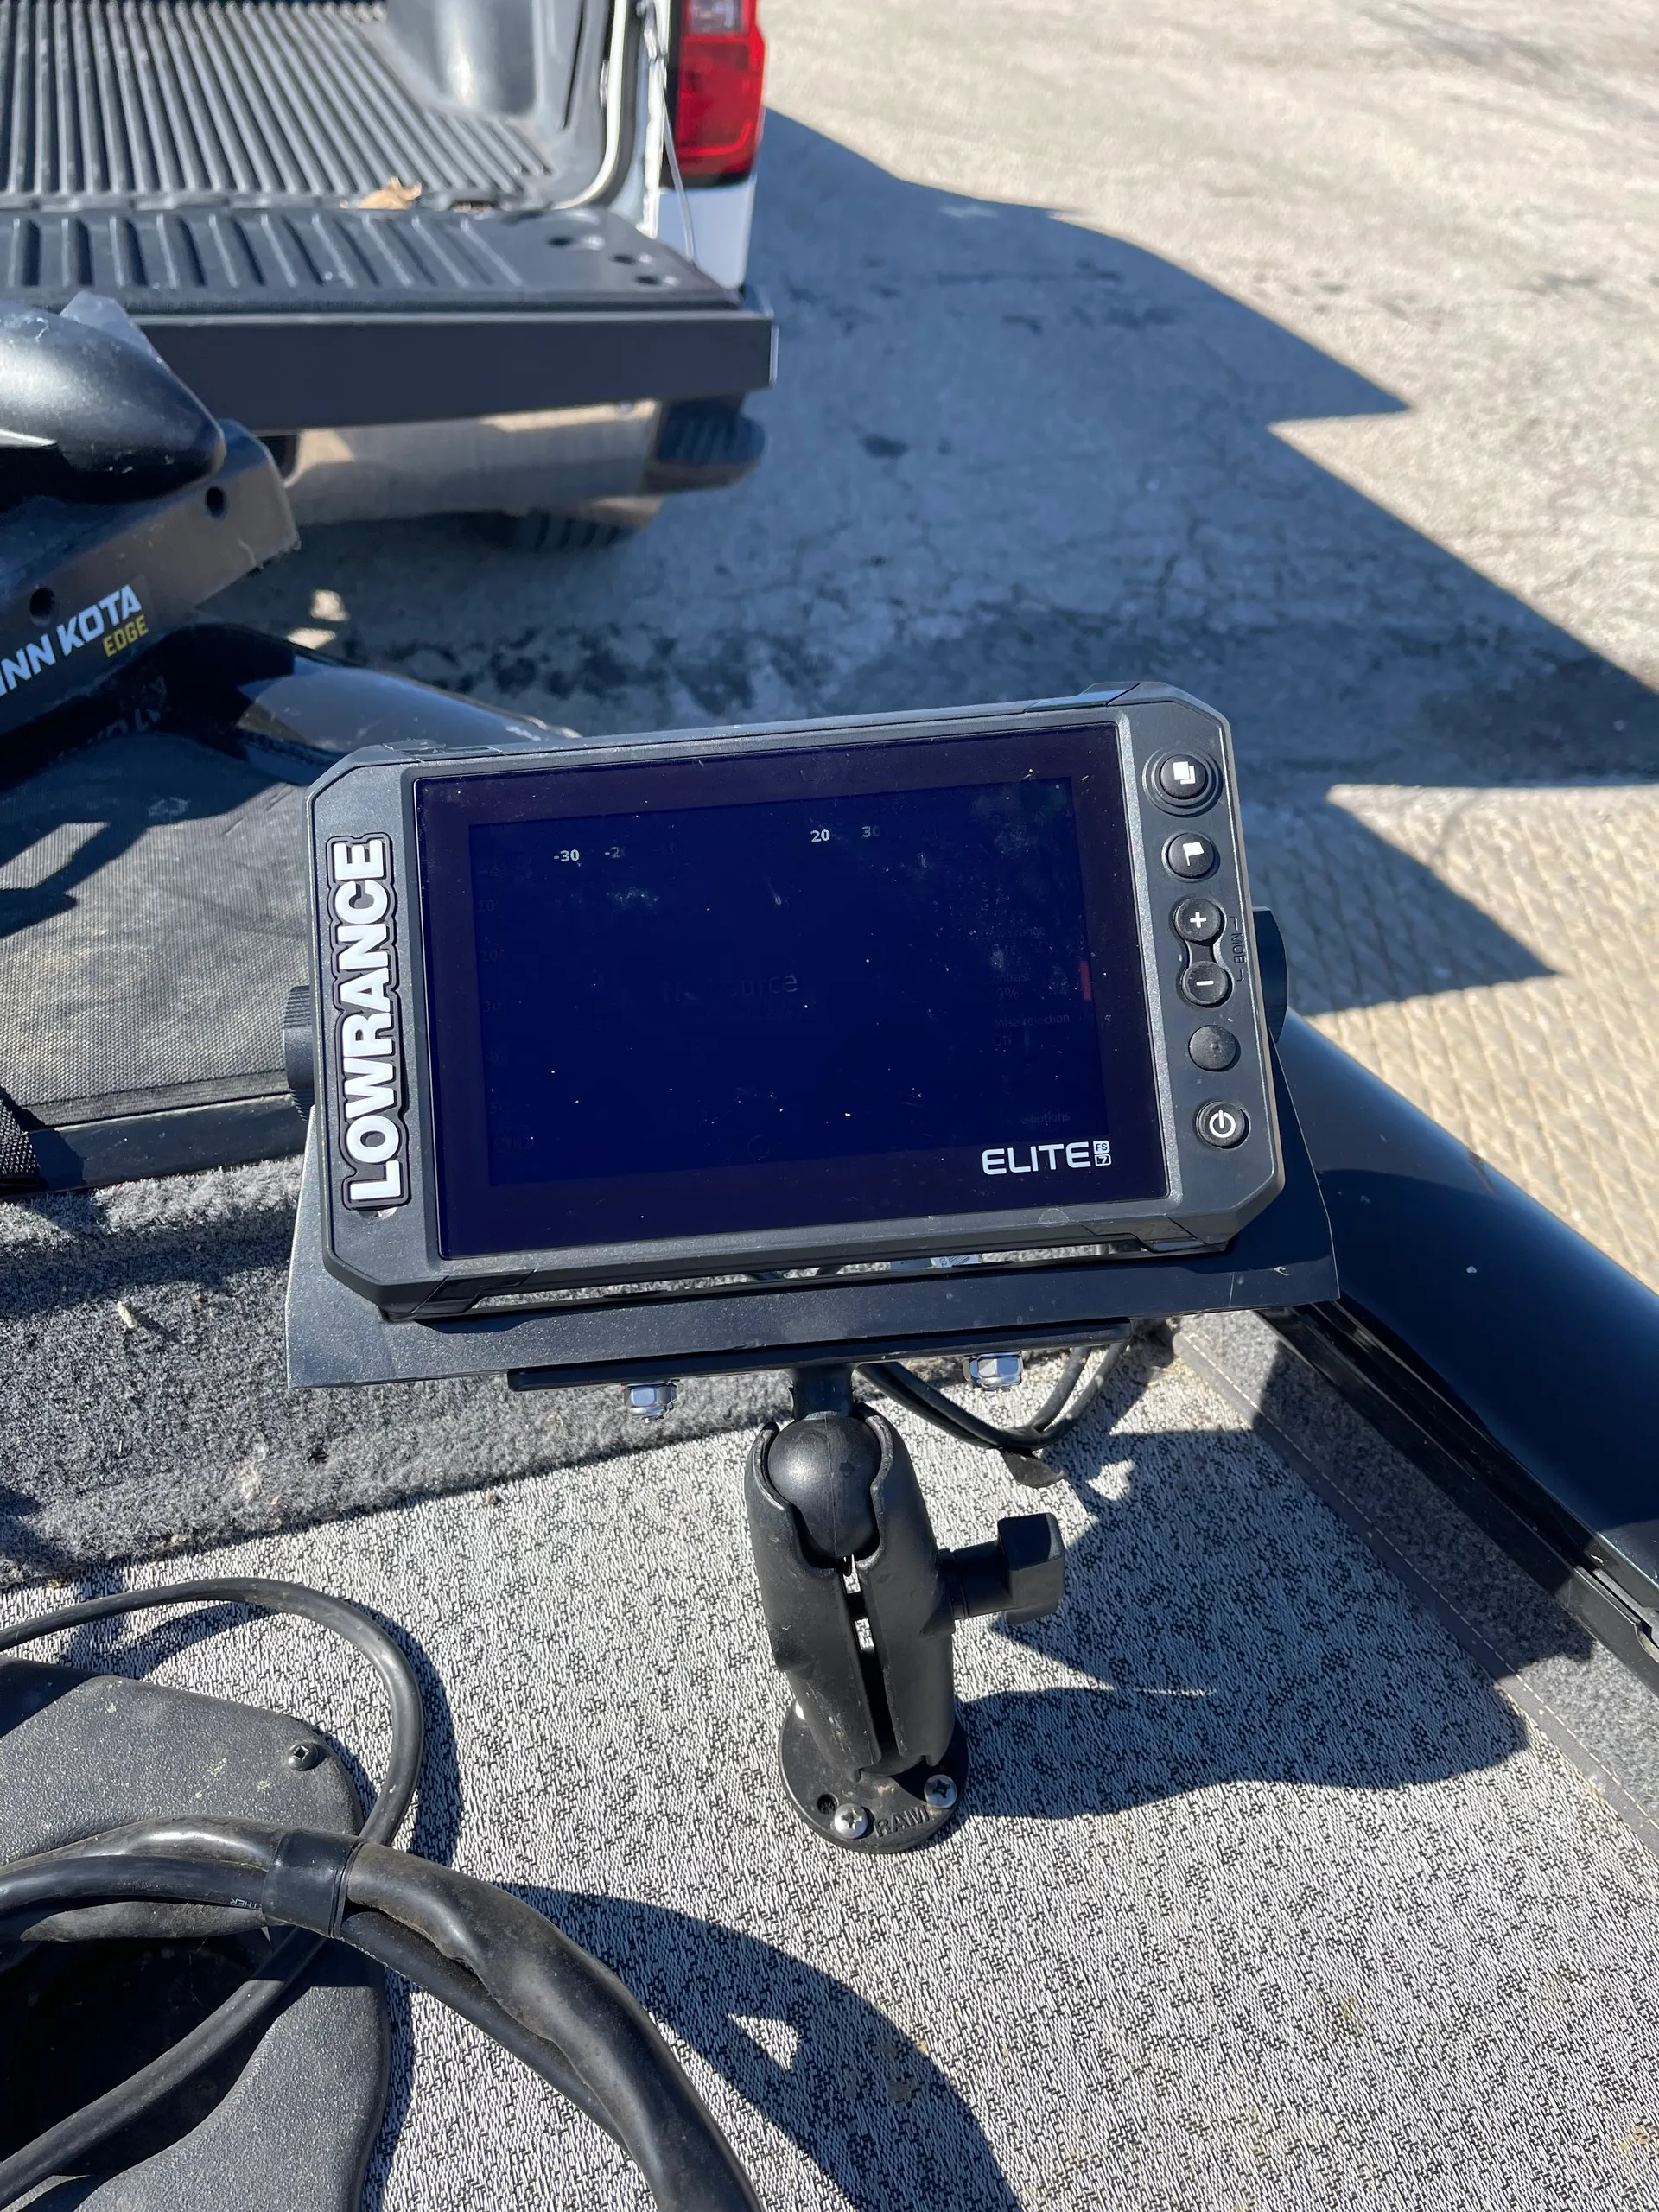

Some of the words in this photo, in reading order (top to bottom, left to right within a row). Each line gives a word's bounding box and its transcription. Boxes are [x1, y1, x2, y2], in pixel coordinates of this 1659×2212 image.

[56, 584, 142, 657] KOTA
[103, 614, 149, 657] EDGE
[554, 849, 580, 862] -30
[810, 829, 830, 842] 20
[1231, 932, 1246, 964] MOB
[334, 838, 401, 1201] LOWRANCE
[982, 1141, 1091, 1175] ELITE
[1095, 1142, 1109, 1152] FS
[873, 1805, 929, 1838] RAM
